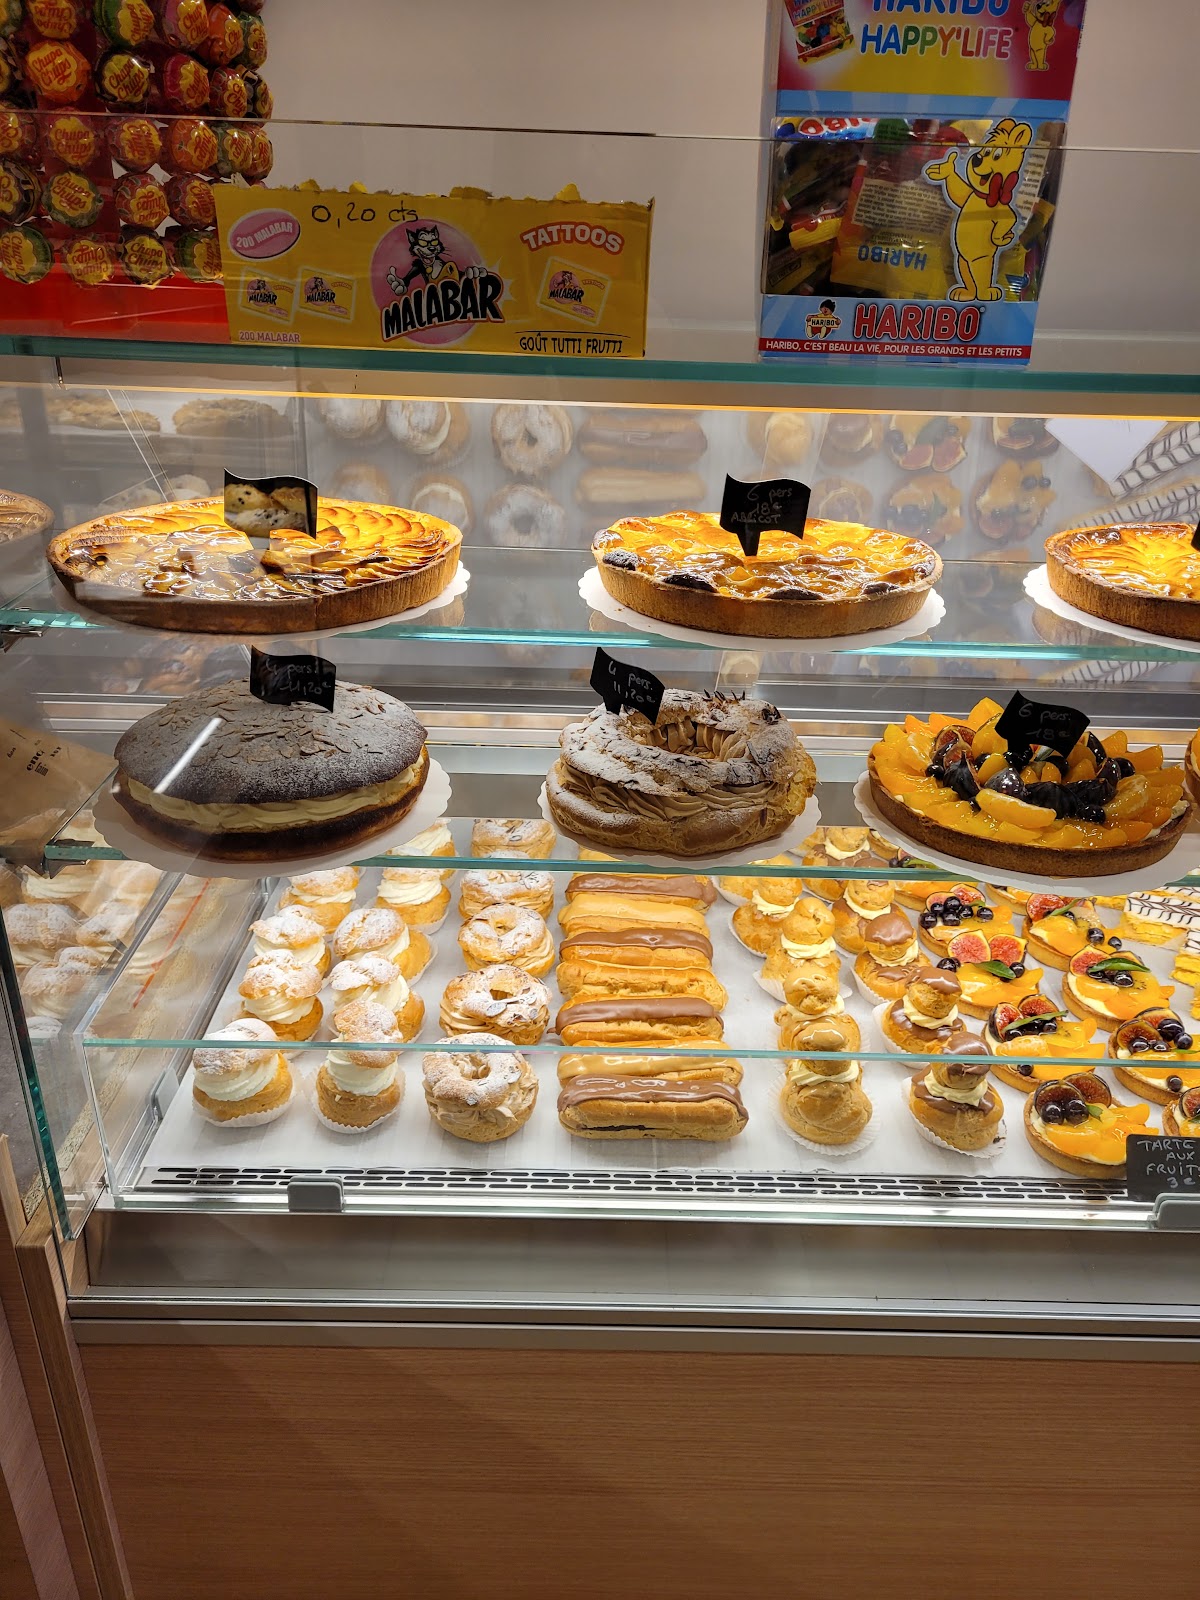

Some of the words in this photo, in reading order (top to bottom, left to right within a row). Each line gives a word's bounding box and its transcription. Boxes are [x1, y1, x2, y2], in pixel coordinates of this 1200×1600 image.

[860, 24, 1013, 59] HAPPY'LIFE
[32, 48, 63, 73] Chupa
[40, 57, 72, 87] Chups
[109, 58, 136, 89] Chupa
[117, 68, 145, 100] Chups
[54, 128, 90, 144] Chupa
[56, 141, 92, 161] Chups
[56, 175, 92, 199] Chupa
[52, 185, 88, 211] Chups
[311, 202, 376, 229] 0,20
[388, 202, 420, 222] cts
[236, 236, 255, 249] 200
[254, 221, 294, 244] MALABAR
[521, 222, 624, 254] TATTOOS
[130, 242, 163, 258] Chupa
[857, 244, 928, 271] HARIBO
[127, 253, 163, 272] Chups
[248, 293, 278, 306] MALABAR
[305, 292, 336, 304] MALABAR
[549, 288, 585, 304] MALABAR
[384, 272, 505, 342] MALABAR
[811, 318, 835, 327] HARIBO
[855, 304, 981, 342] HARIBO
[239, 331, 255, 341] 200
[257, 332, 301, 343] MALABAR
[519, 333, 548, 352] GOÛT
[551, 337, 582, 354] TUTTI
[585, 338, 623, 354] FRUTTI
[765, 340, 802, 352] HARIBO,
[804, 342, 827, 351] C'EST
[828, 342, 852, 352] BEAU
[854, 344, 865, 352] LA
[866, 344, 882, 354] VIE,
[884, 345, 909, 353] POUR
[911, 345, 925, 354] LES
[927, 345, 965, 355] GRANDS
[967, 347, 977, 356] ET
[978, 347, 993, 356] LES
[995, 347, 1023, 357] PETITS
[746, 483, 761, 501] 6
[1018, 702, 1034, 718] 6
[1136, 1138, 1197, 1152] TARTE
[1165, 1151, 1196, 1162] AUX
